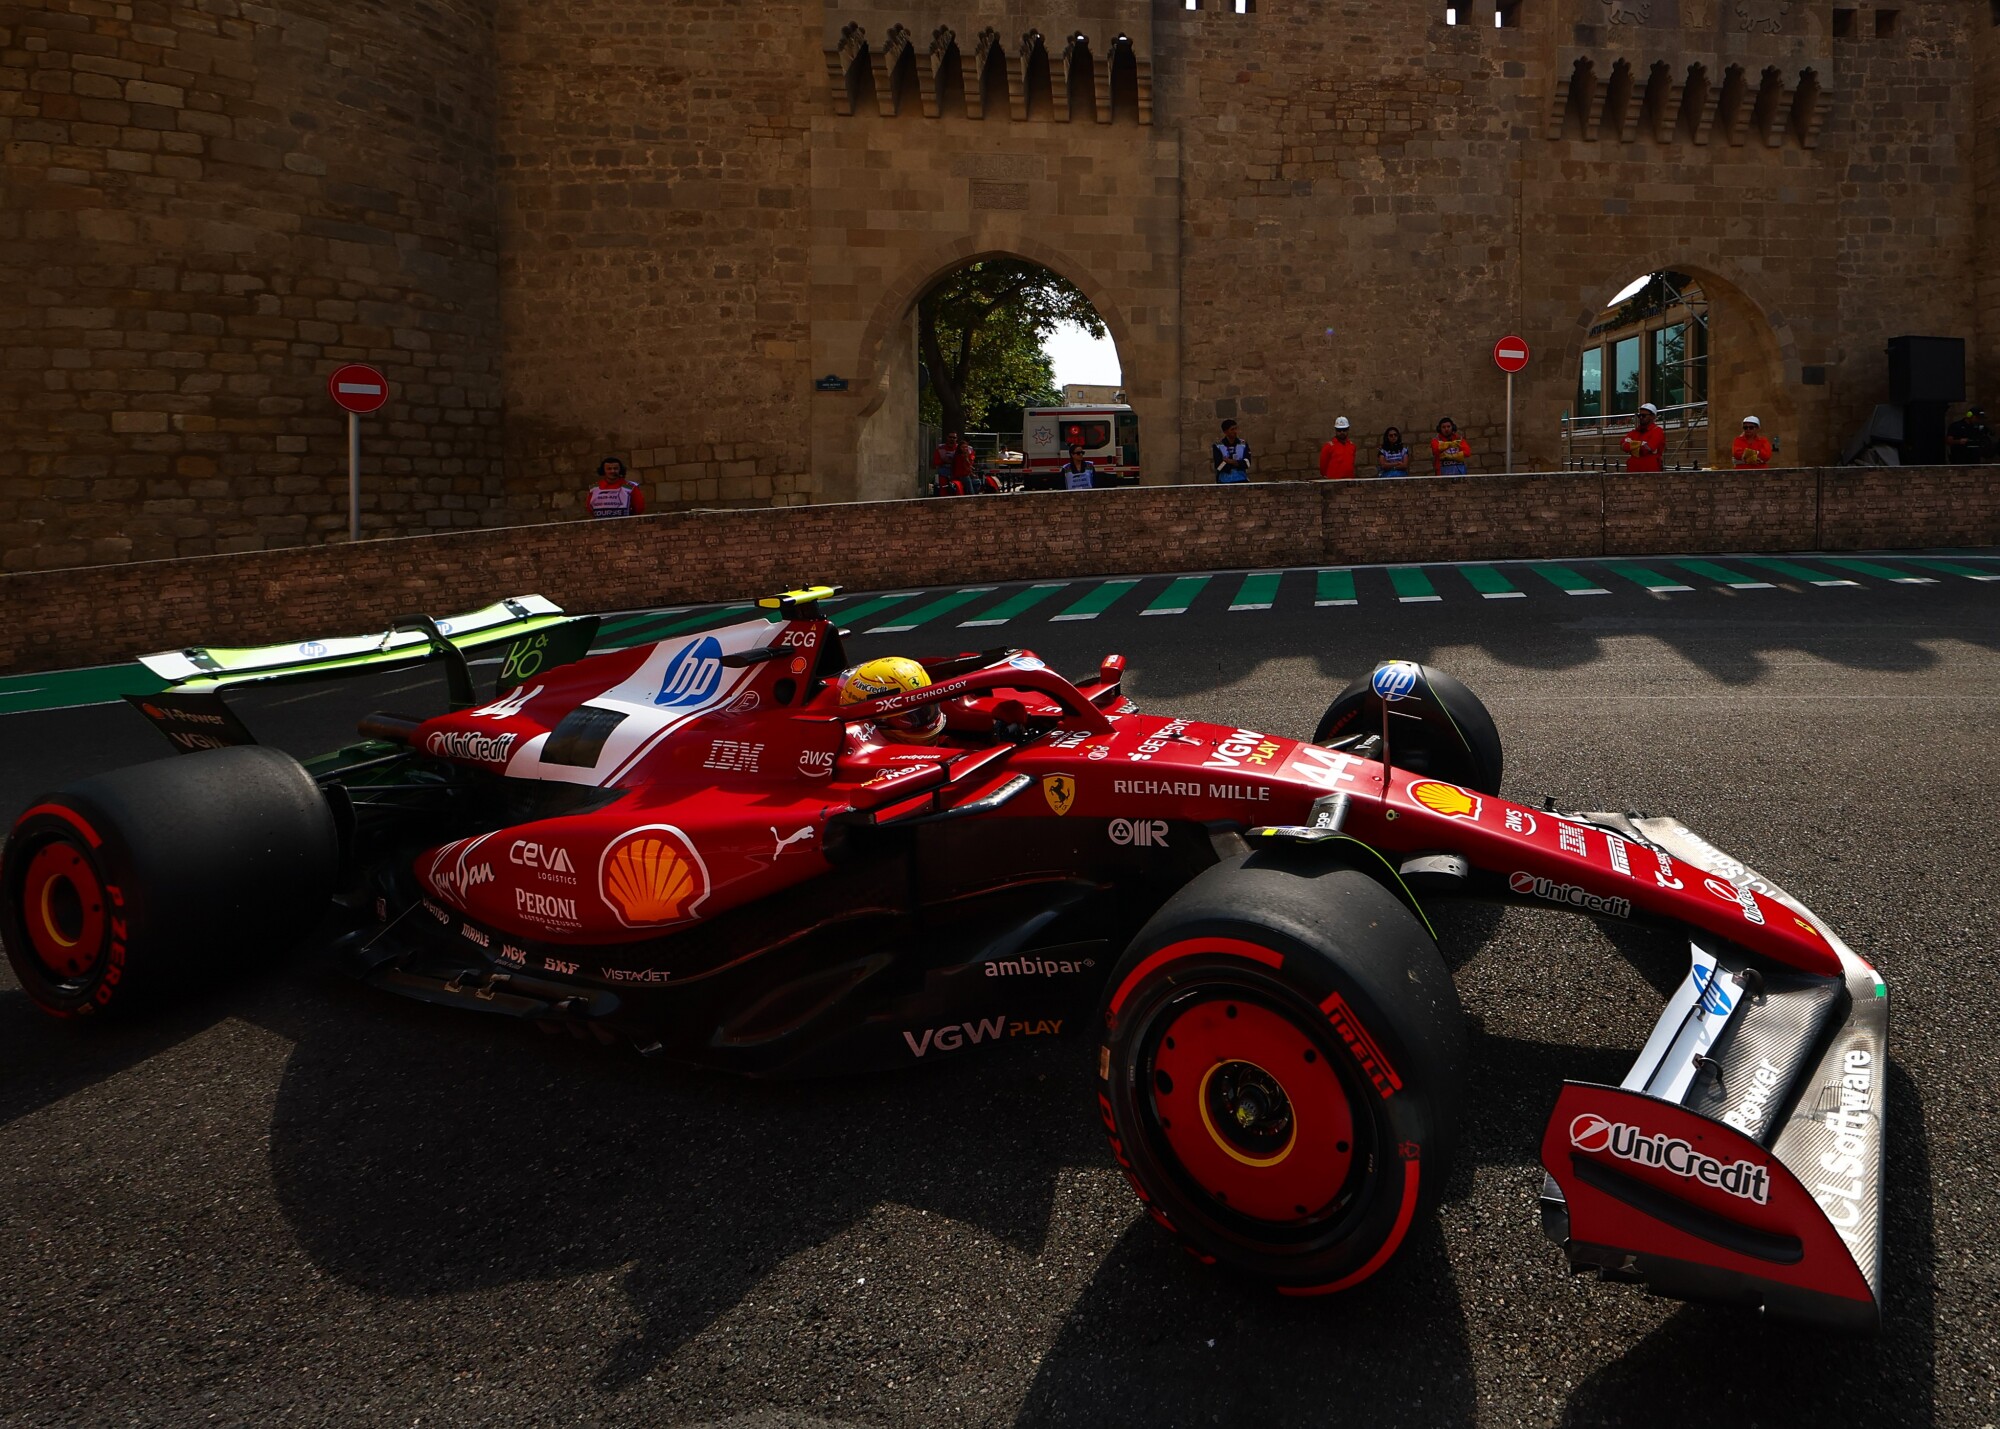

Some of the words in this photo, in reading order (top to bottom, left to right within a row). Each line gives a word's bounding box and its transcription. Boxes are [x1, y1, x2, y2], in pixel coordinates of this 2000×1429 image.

[781, 631, 817, 648] ZCG
[661, 637, 722, 706] hp
[1376, 666, 1411, 700] hp
[470, 685, 545, 720] 44
[904, 680, 967, 703] TECHNOLOGY
[444, 731, 518, 762] UniCredit
[703, 740, 765, 772] IBM
[799, 750, 835, 767] aws
[1202, 728, 1266, 768] VGW
[1246, 740, 1281, 766] PLAY
[1291, 747, 1364, 787] 44
[1113, 780, 1200, 797] RICHARD
[1209, 783, 1271, 802] MILLE
[1505, 807, 1522, 833] aws
[1558, 821, 1587, 858] IBM
[537, 871, 577, 886] LOGISTICS
[105, 884, 125, 908] P
[515, 887, 578, 920] PERONI
[1534, 877, 1632, 919] UniCredit
[461, 922, 491, 948] MAHLE
[95, 915, 128, 1007] ZERO
[501, 943, 527, 965] NGK
[543, 957, 581, 975] SKF
[984, 956, 1083, 978] ambipar
[902, 1015, 1006, 1058] VGW
[1009, 1018, 1064, 1037] PLAY
[1317, 990, 1404, 1100] PIRELLI
[1608, 1122, 1770, 1206] UniCredit
